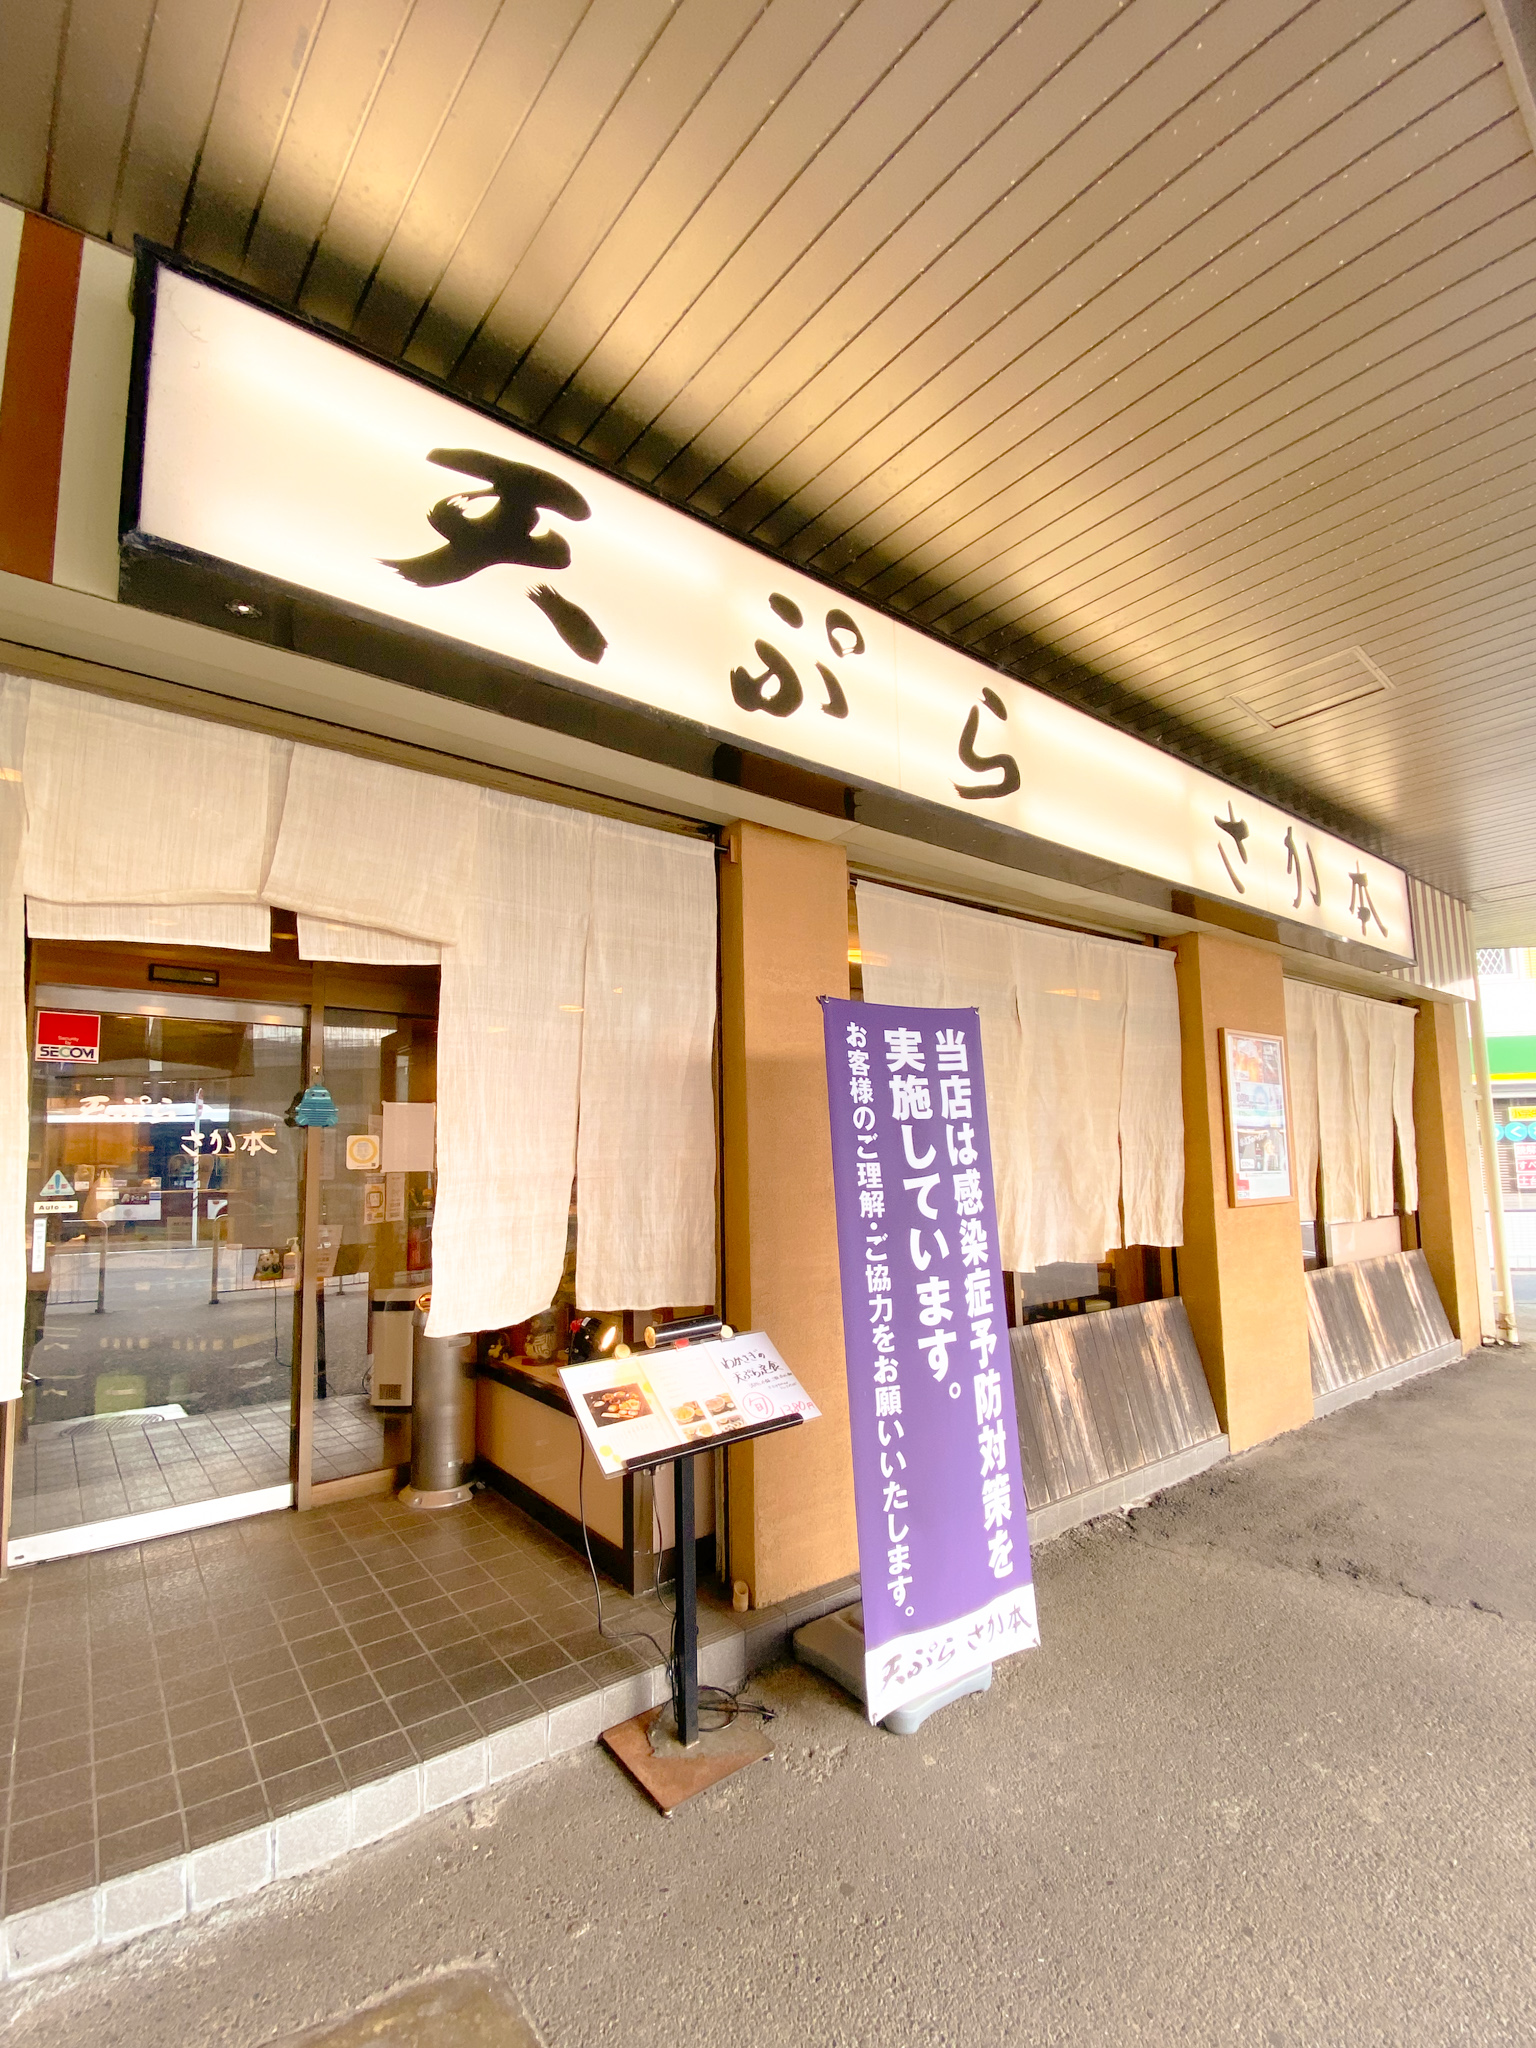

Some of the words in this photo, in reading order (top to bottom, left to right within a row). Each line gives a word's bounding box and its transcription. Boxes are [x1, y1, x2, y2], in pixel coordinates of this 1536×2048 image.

[376, 447, 1021, 799] 天ぷら
[1214, 800, 1388, 937] さか本
[40, 1046, 94, 1059] SECOM
[181, 1129, 277, 1156] さか本
[883, 1027, 961, 1399] 実施しています。
[845, 1021, 915, 1616] お客様のご理解・ご協力をお願いいたします。
[935, 1028, 1014, 1579] 当店は感染症予防対策を
[882, 1638, 956, 1690] 天ぷら
[967, 1603, 1032, 1650] さか本
